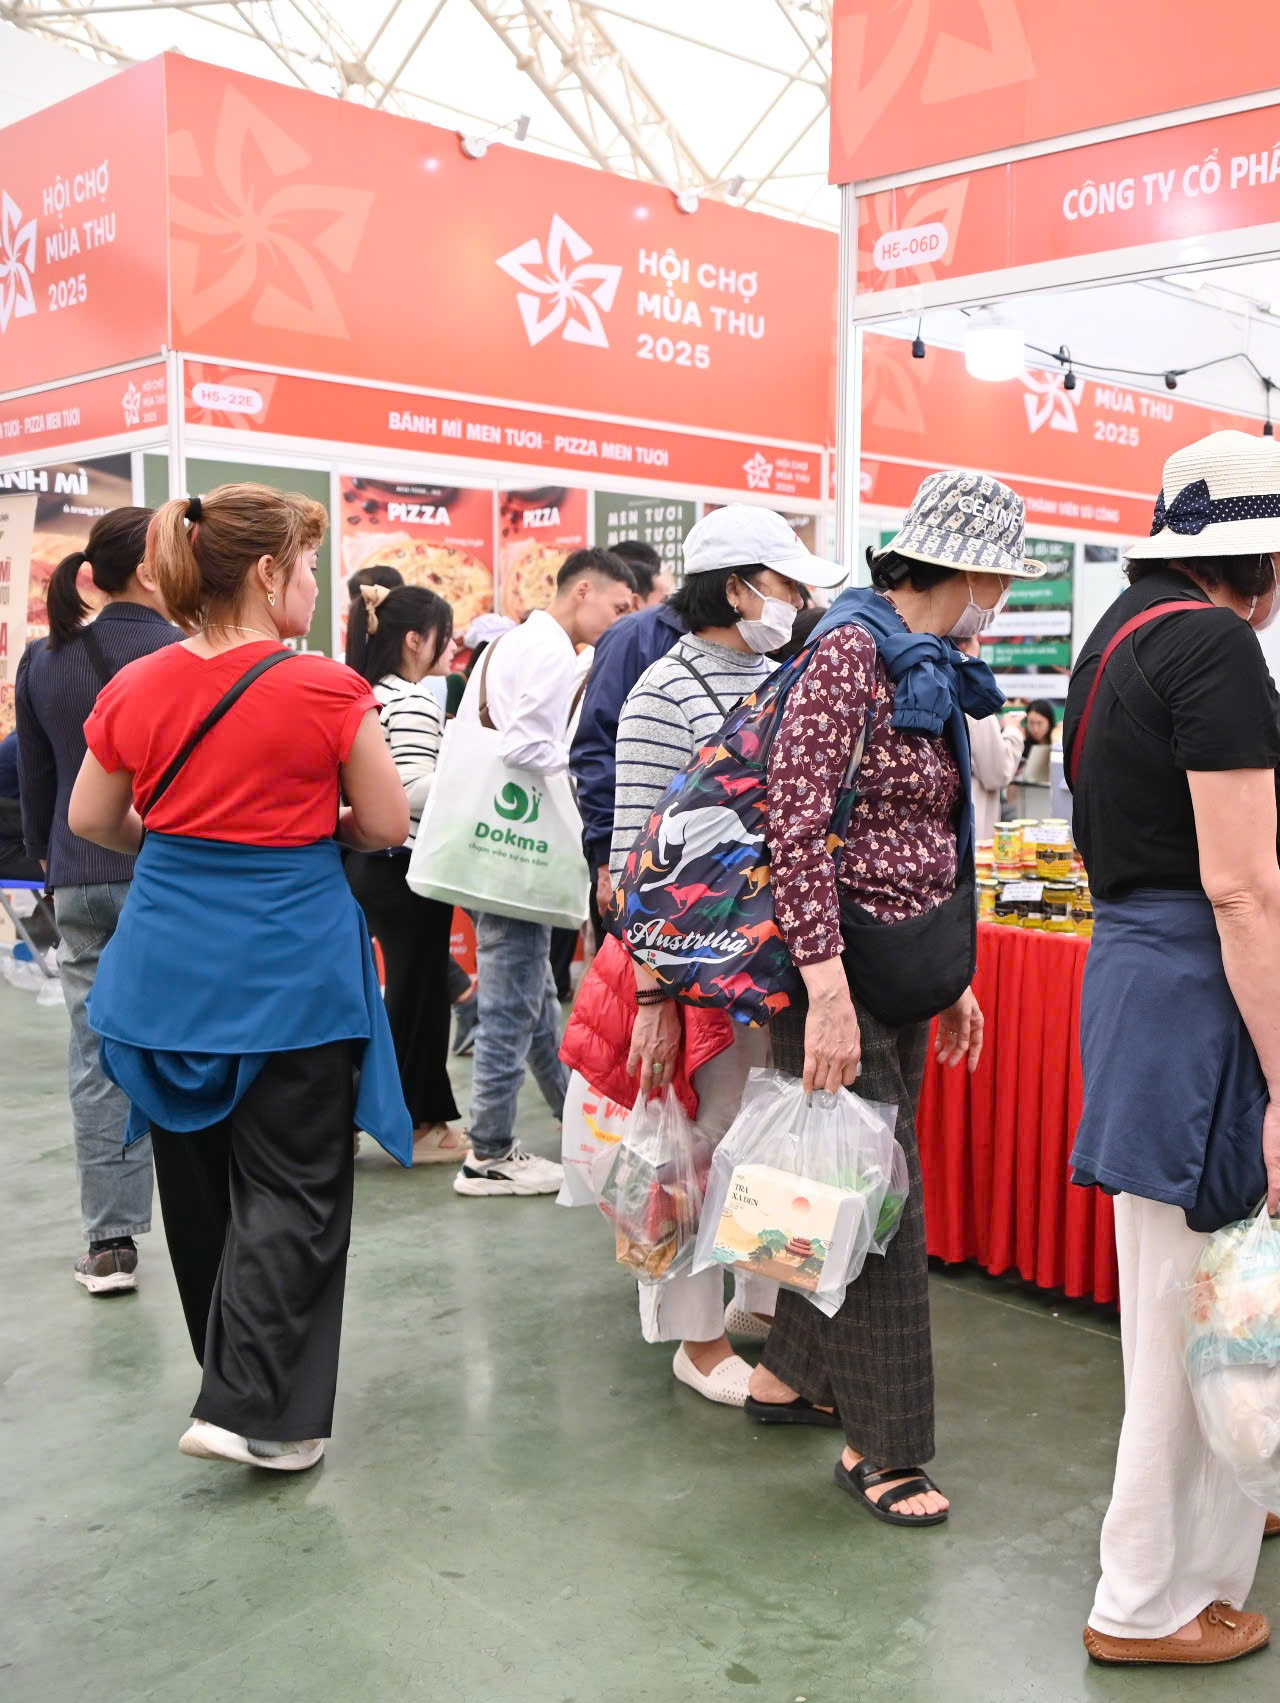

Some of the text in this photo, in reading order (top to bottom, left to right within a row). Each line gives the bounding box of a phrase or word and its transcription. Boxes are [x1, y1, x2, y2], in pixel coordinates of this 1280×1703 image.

[43, 159, 109, 218] HỘI CHỢ
[1062, 180, 1134, 220] CÔNG
[1142, 169, 1175, 205] TY
[1182, 148, 1221, 197] CỔ
[46, 212, 116, 264] MÙA THU
[881, 234, 940, 260] H5-06D
[48, 273, 87, 312] 2025
[638, 248, 759, 304] HỘI CHỢ
[637, 289, 765, 339] MÙA THU
[636, 334, 711, 369] 2025
[1095, 387, 1174, 422] MÙA THU
[388, 410, 437, 435] BÁNH
[466, 422, 501, 444] MEN
[554, 435, 597, 457] PIZZA
[601, 441, 632, 463] MEN
[1094, 421, 1140, 447] 2025
[54, 468, 88, 495] MÌ
[387, 501, 451, 527] PIZZA
[523, 507, 560, 528] PIZZA
[608, 509, 638, 526] MEN
[958, 496, 1020, 532] CELINE
[608, 528, 638, 545] MEN
[475, 821, 548, 854] Dokma
[627, 918, 748, 952] Australia
